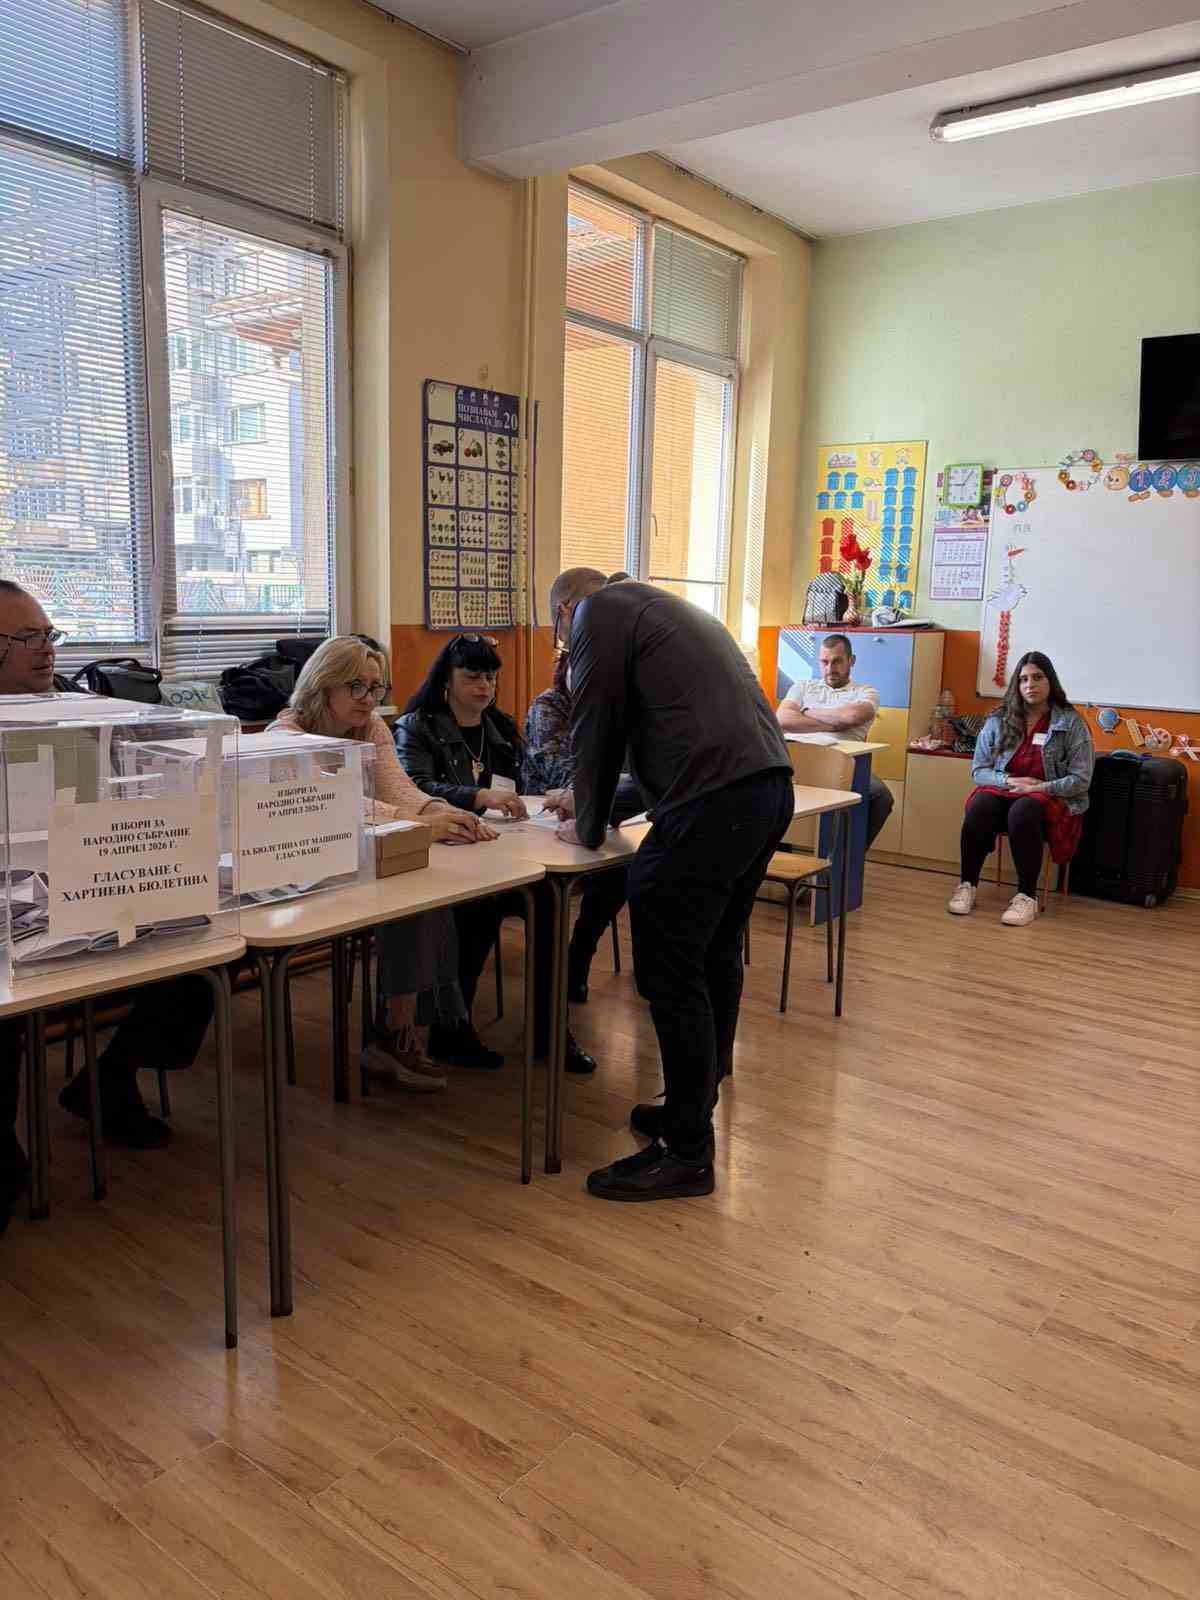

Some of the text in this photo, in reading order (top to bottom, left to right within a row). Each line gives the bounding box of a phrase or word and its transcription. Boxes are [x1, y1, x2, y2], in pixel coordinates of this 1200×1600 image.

[503, 411, 518, 431] 20
[277, 785, 318, 798] ИЗБОРИ ЗА
[256, 792, 337, 810] НАРОДНО СЪБРАНИЕ
[268, 810, 277, 819] 19
[278, 805, 304, 817] АПРИЛ
[304, 804, 320, 813] 2026
[111, 818, 166, 832] ИЗБОРИ ЗА
[82, 828, 191, 847] НАРОДНО СЪБРАНИЕ
[98, 839, 177, 857] 19 АПРИЛ 2026 Г.
[241, 848, 252, 857] ЗА
[252, 841, 299, 856] БЮЛЕТИНА
[299, 838, 311, 847] ОТ
[275, 846, 321, 861] ГЛАСУВАНЕ
[93, 863, 183, 884] ГЛАСУВАНЕ С
[62, 874, 209, 903] ХАРТИЕНА БЮЛЕТИНА
